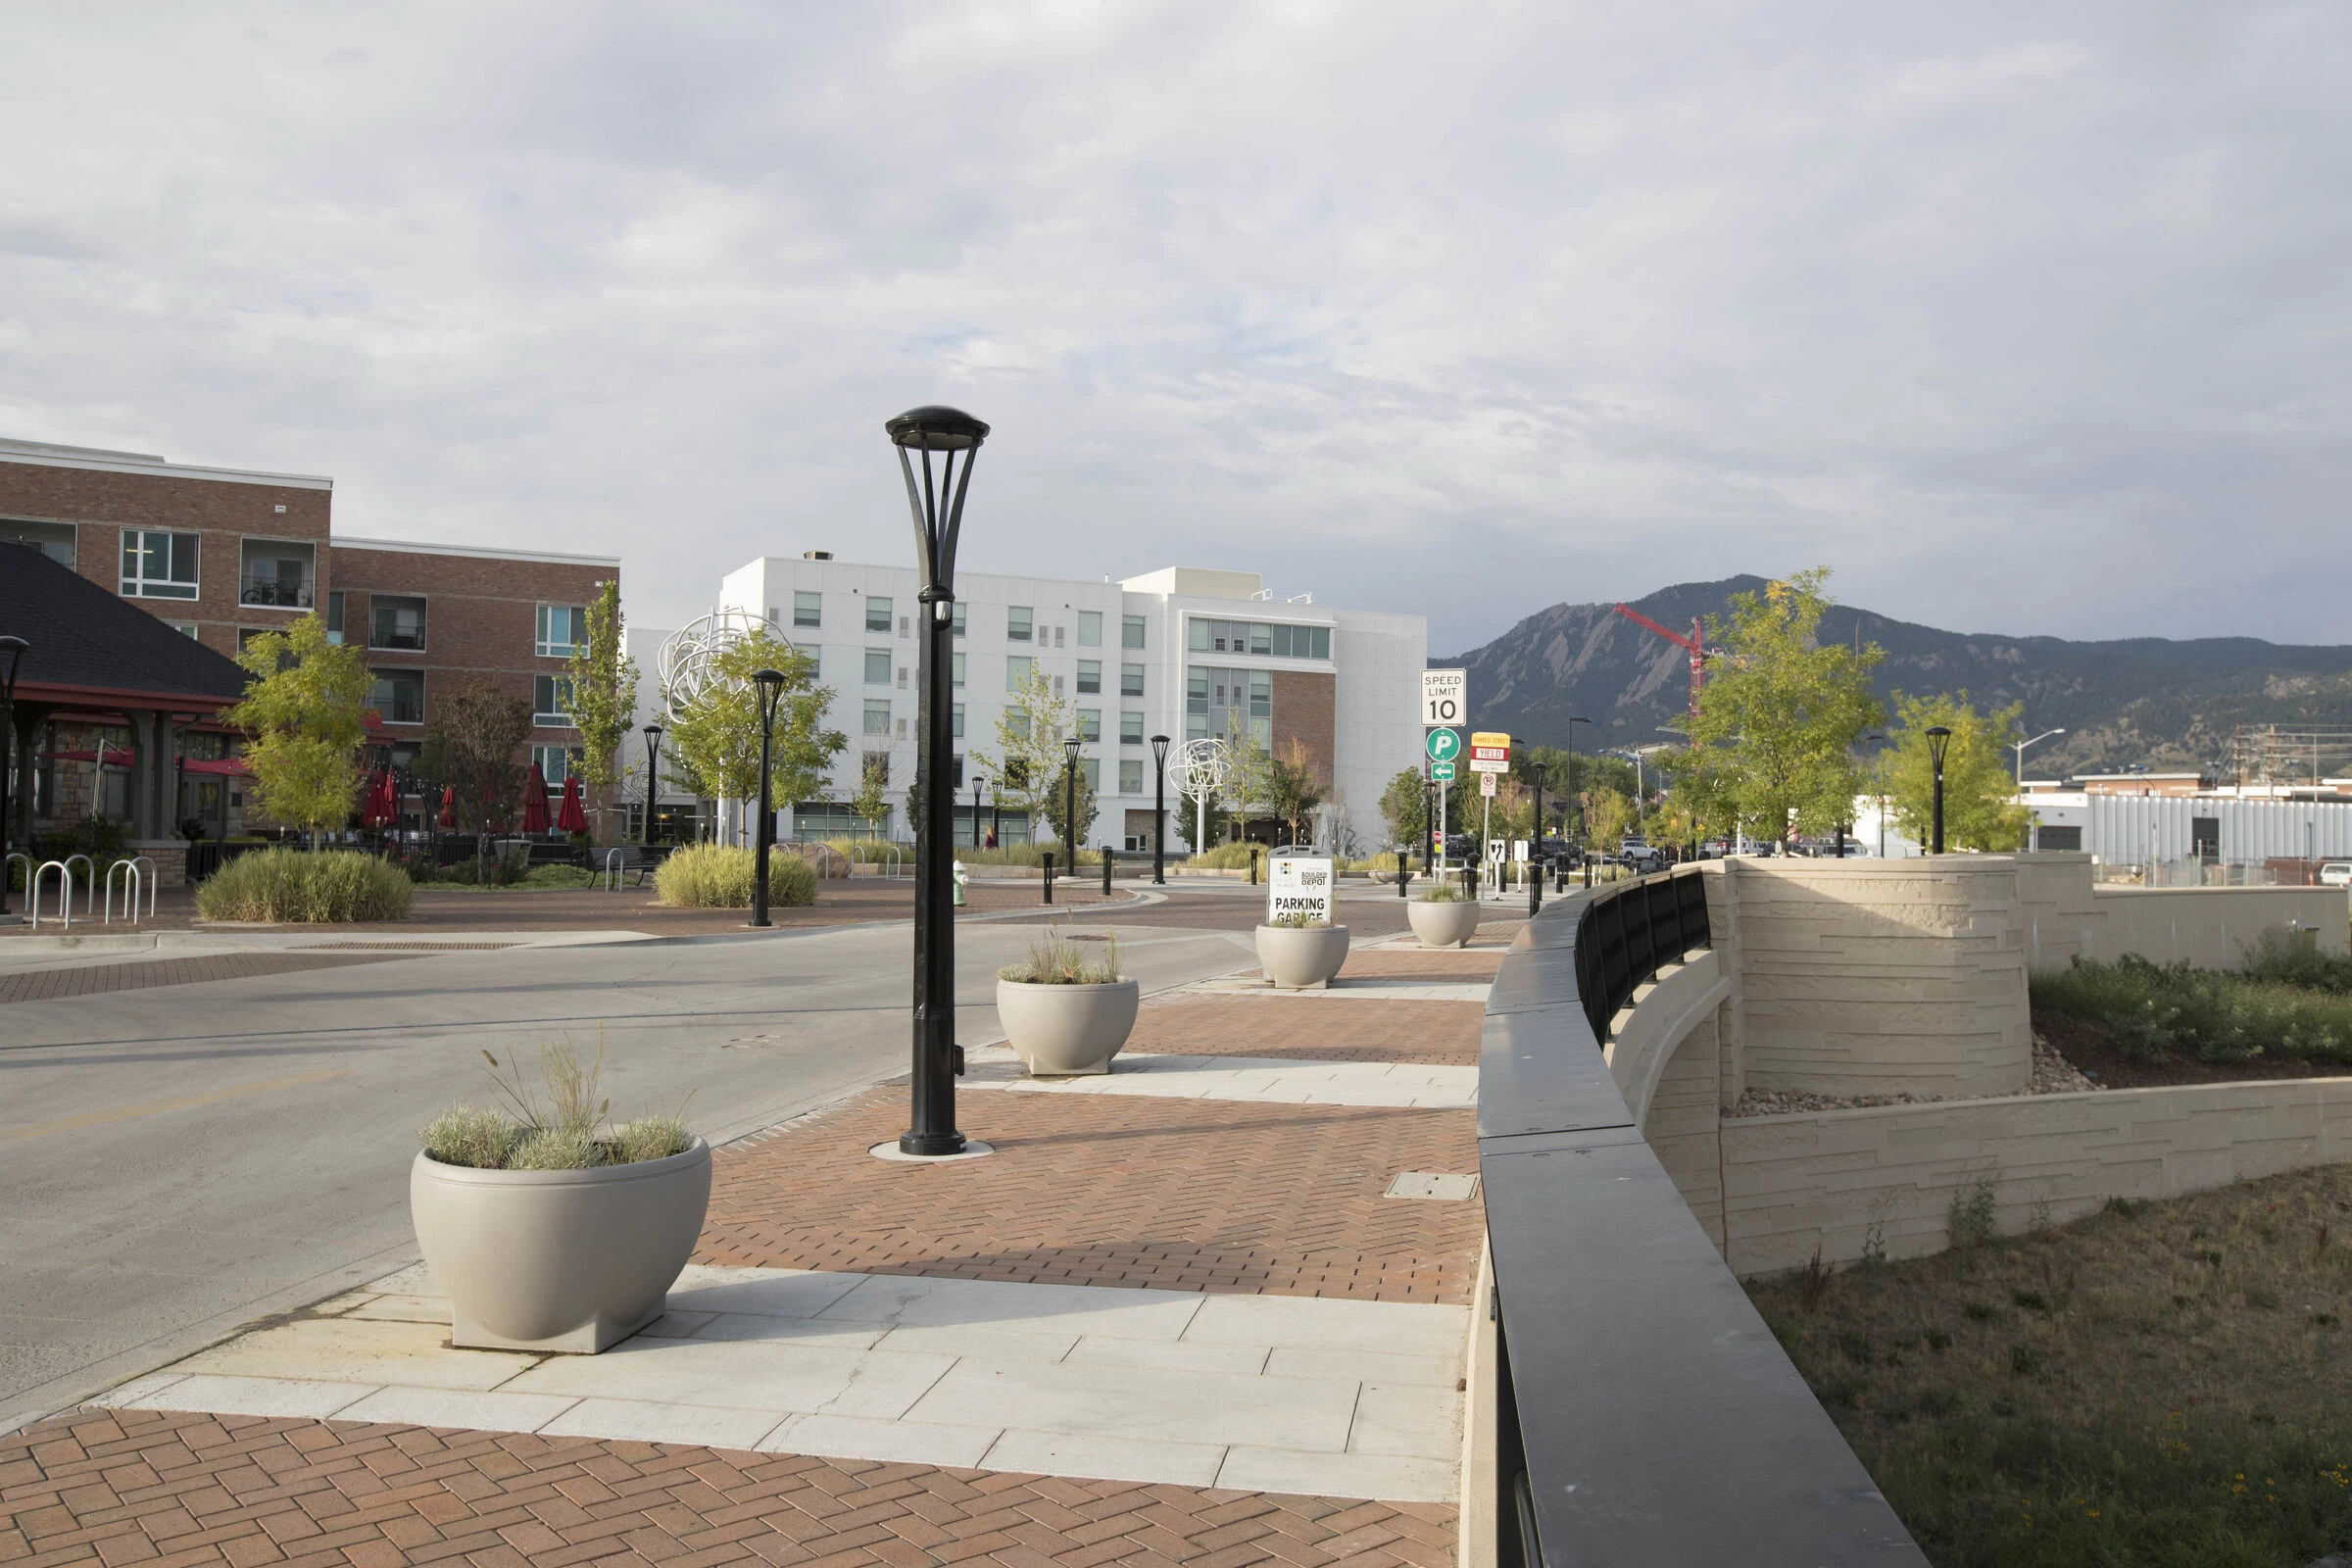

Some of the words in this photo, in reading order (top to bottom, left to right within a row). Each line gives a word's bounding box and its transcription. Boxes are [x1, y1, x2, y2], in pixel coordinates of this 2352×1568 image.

[1425, 676, 1461, 685] SPEED
[1430, 700, 1456, 719] 10
[1435, 736, 1452, 755] P
[1276, 898, 1324, 909] PARKING
